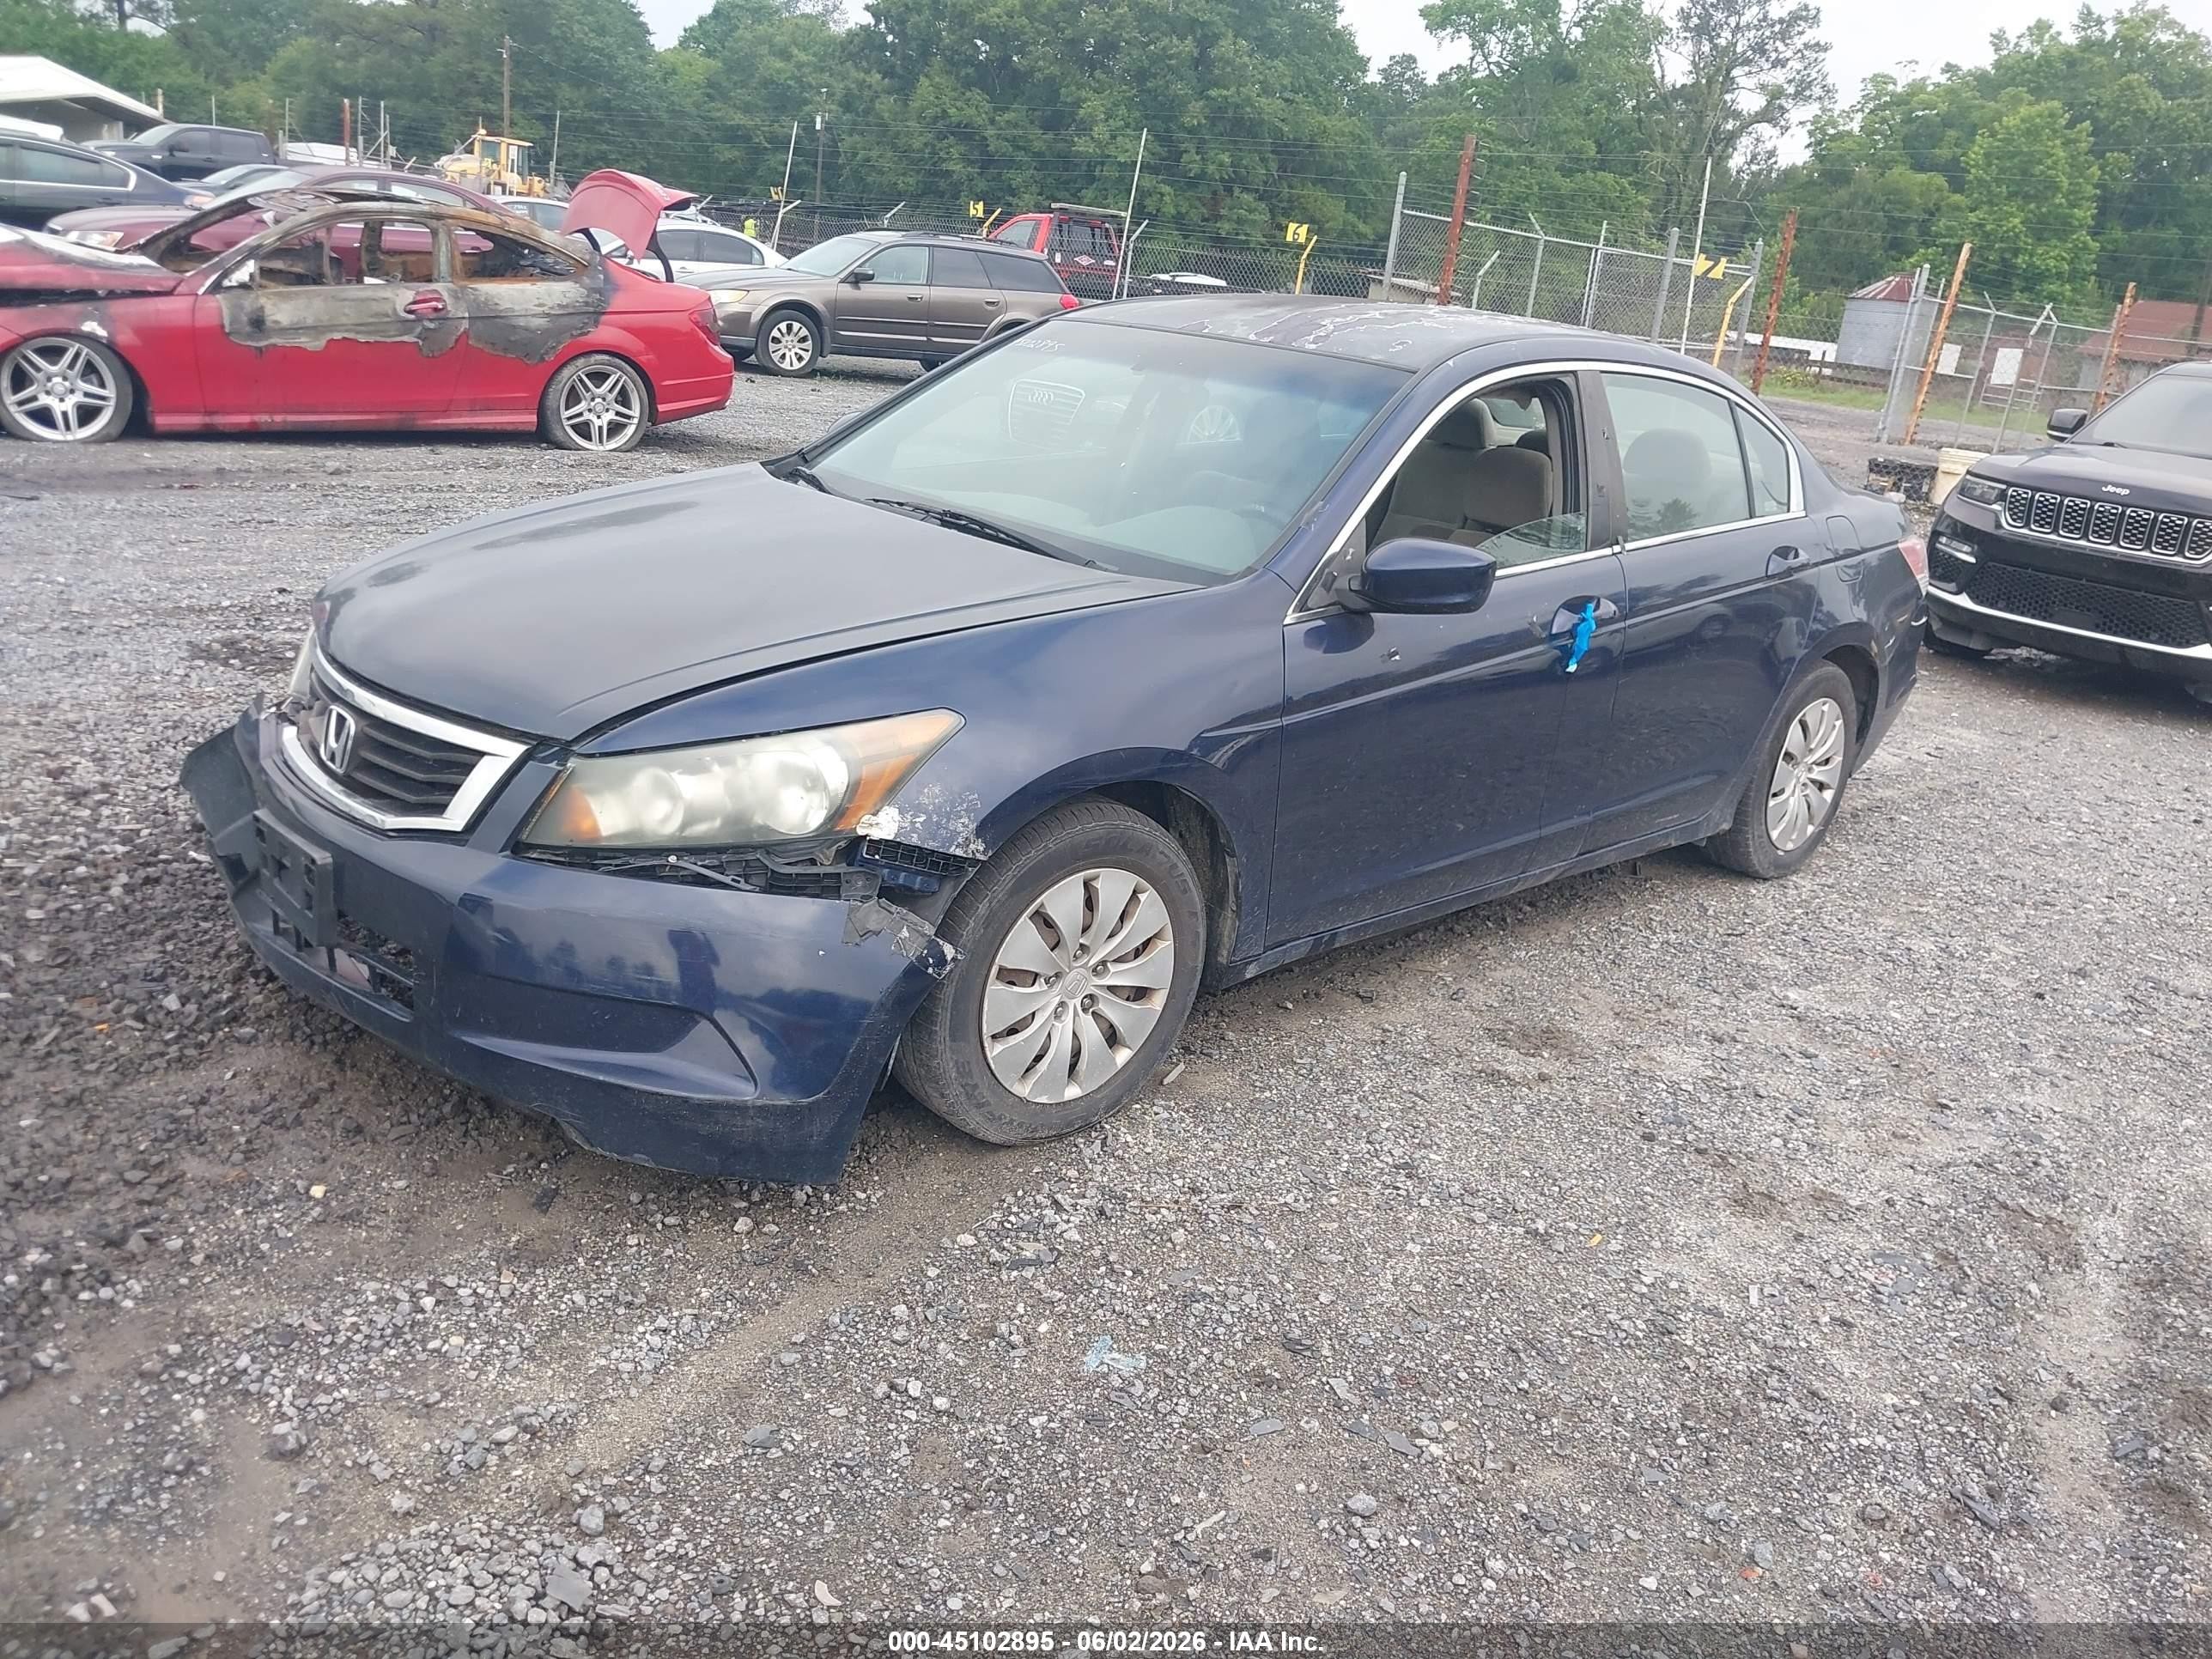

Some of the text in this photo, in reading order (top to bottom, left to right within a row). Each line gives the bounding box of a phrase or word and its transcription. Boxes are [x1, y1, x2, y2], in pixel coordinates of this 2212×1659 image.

[972, 201, 980, 213] 5
[1292, 224, 1303, 241] 6
[2101, 484, 2130, 496] Jeep
